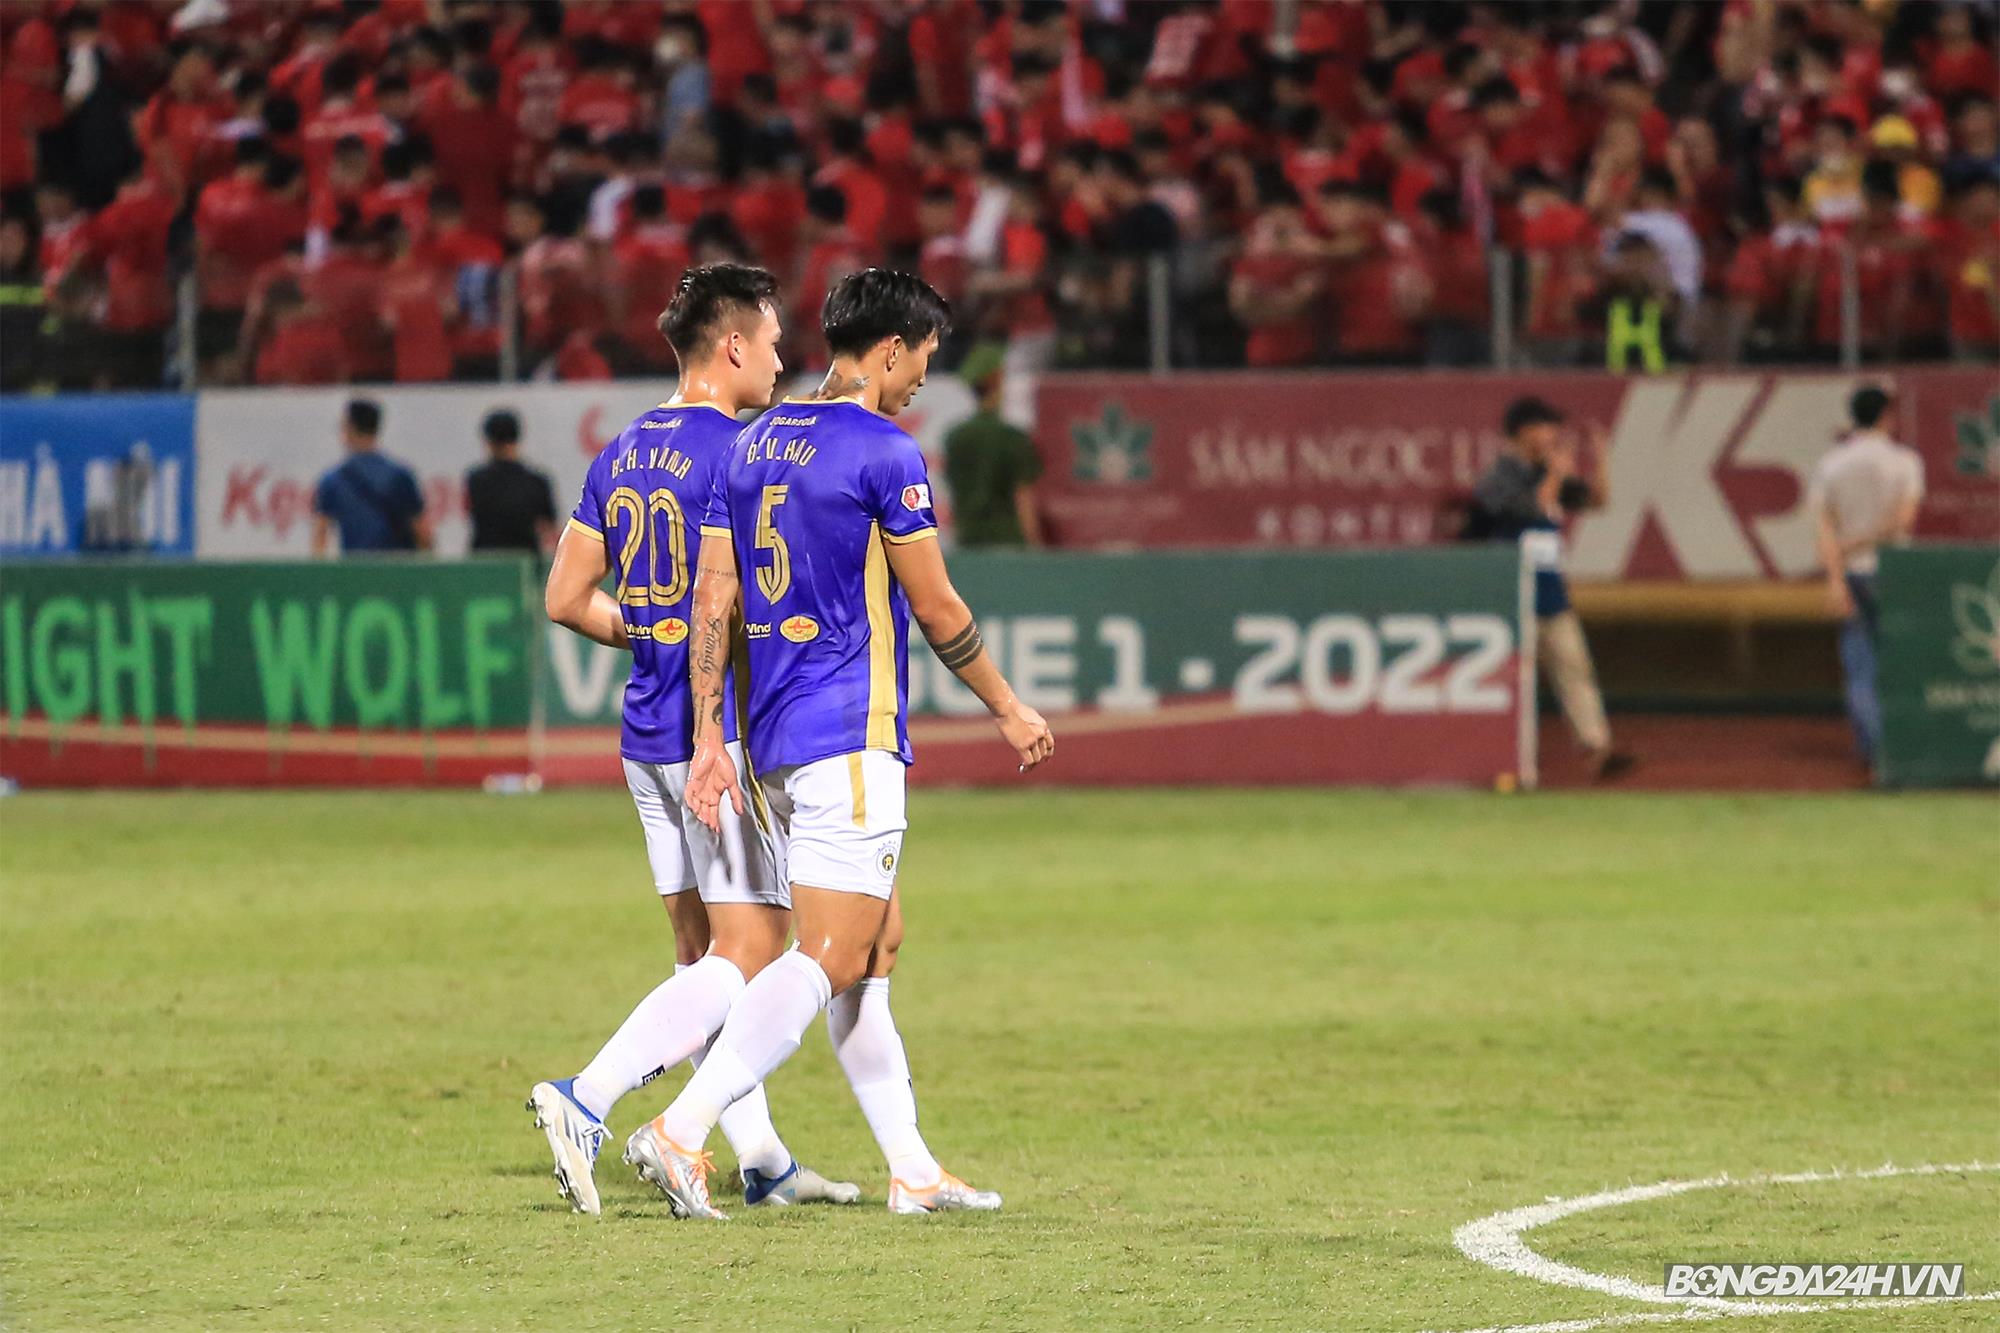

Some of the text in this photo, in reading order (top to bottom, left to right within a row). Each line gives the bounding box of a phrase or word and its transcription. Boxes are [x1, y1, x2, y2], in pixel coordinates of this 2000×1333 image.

[606, 486, 689, 607] 20
[755, 484, 791, 606] 5
[250, 592, 512, 735] WOLF
[1233, 613, 1513, 713] 2022
